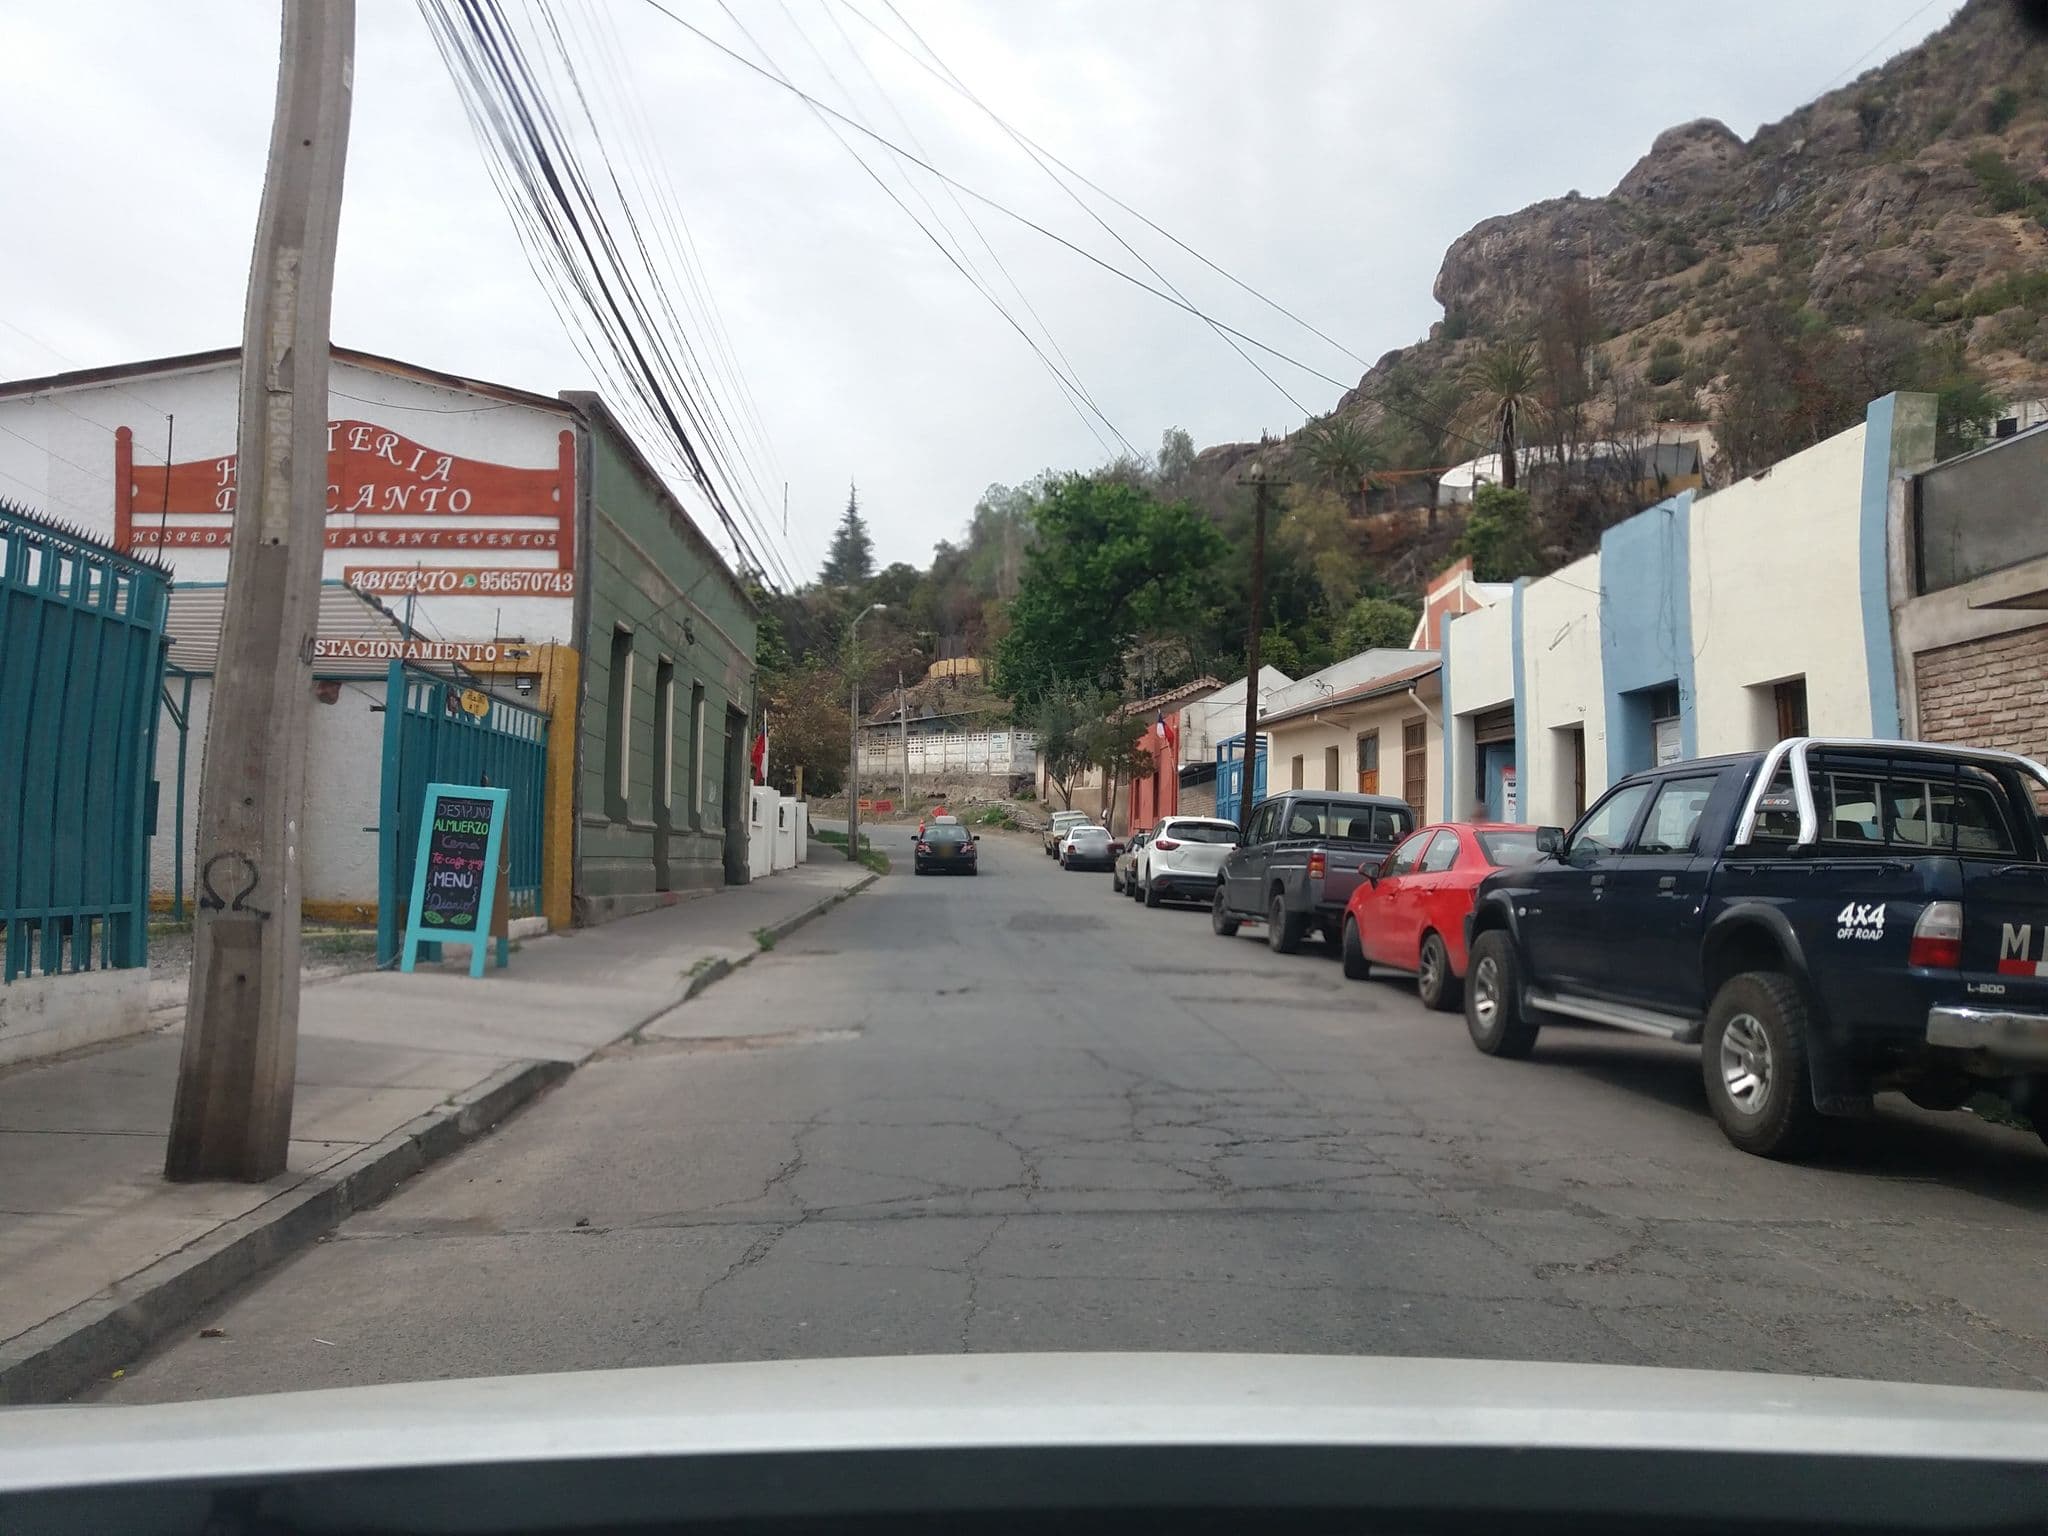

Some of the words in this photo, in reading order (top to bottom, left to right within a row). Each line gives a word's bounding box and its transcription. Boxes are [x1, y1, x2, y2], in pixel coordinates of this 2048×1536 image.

[457, 533, 556, 545] EVENTOS
[351, 569, 458, 593] ABIERTO
[480, 573, 573, 592] 956570743
[433, 818, 489, 836] ALMUERZO
[433, 871, 473, 889] MENÚ
[1837, 928, 1855, 939] OFF
[1855, 928, 1884, 940] ROAD
